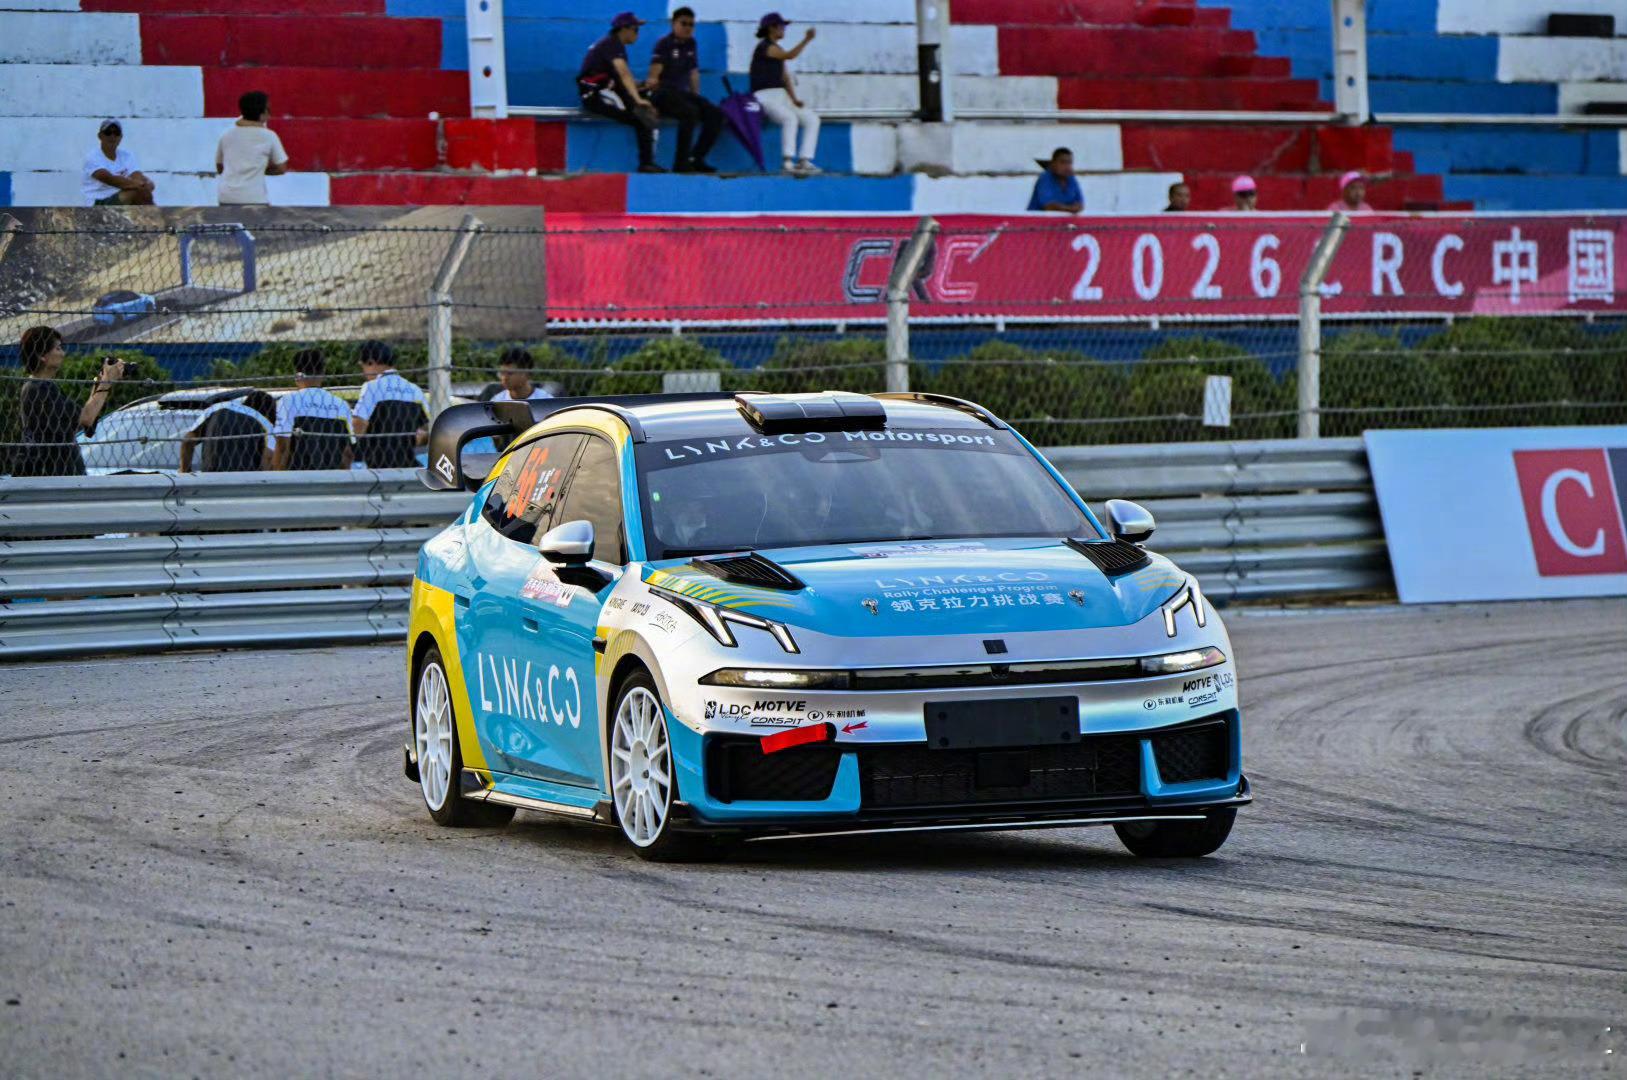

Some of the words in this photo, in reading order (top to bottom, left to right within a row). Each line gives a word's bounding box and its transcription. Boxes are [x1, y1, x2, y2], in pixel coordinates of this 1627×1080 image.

[844, 429, 997, 448] Motorsport
[1541, 468, 1605, 557] C
[883, 588, 919, 599] Rally
[923, 585, 994, 597] Challenge
[998, 584, 1058, 593] Program
[890, 593, 1065, 612] 领克拉力挑战赛
[1183, 676, 1212, 693] MOTVE
[719, 704, 752, 716] LDC
[753, 700, 807, 712] MOTVE
